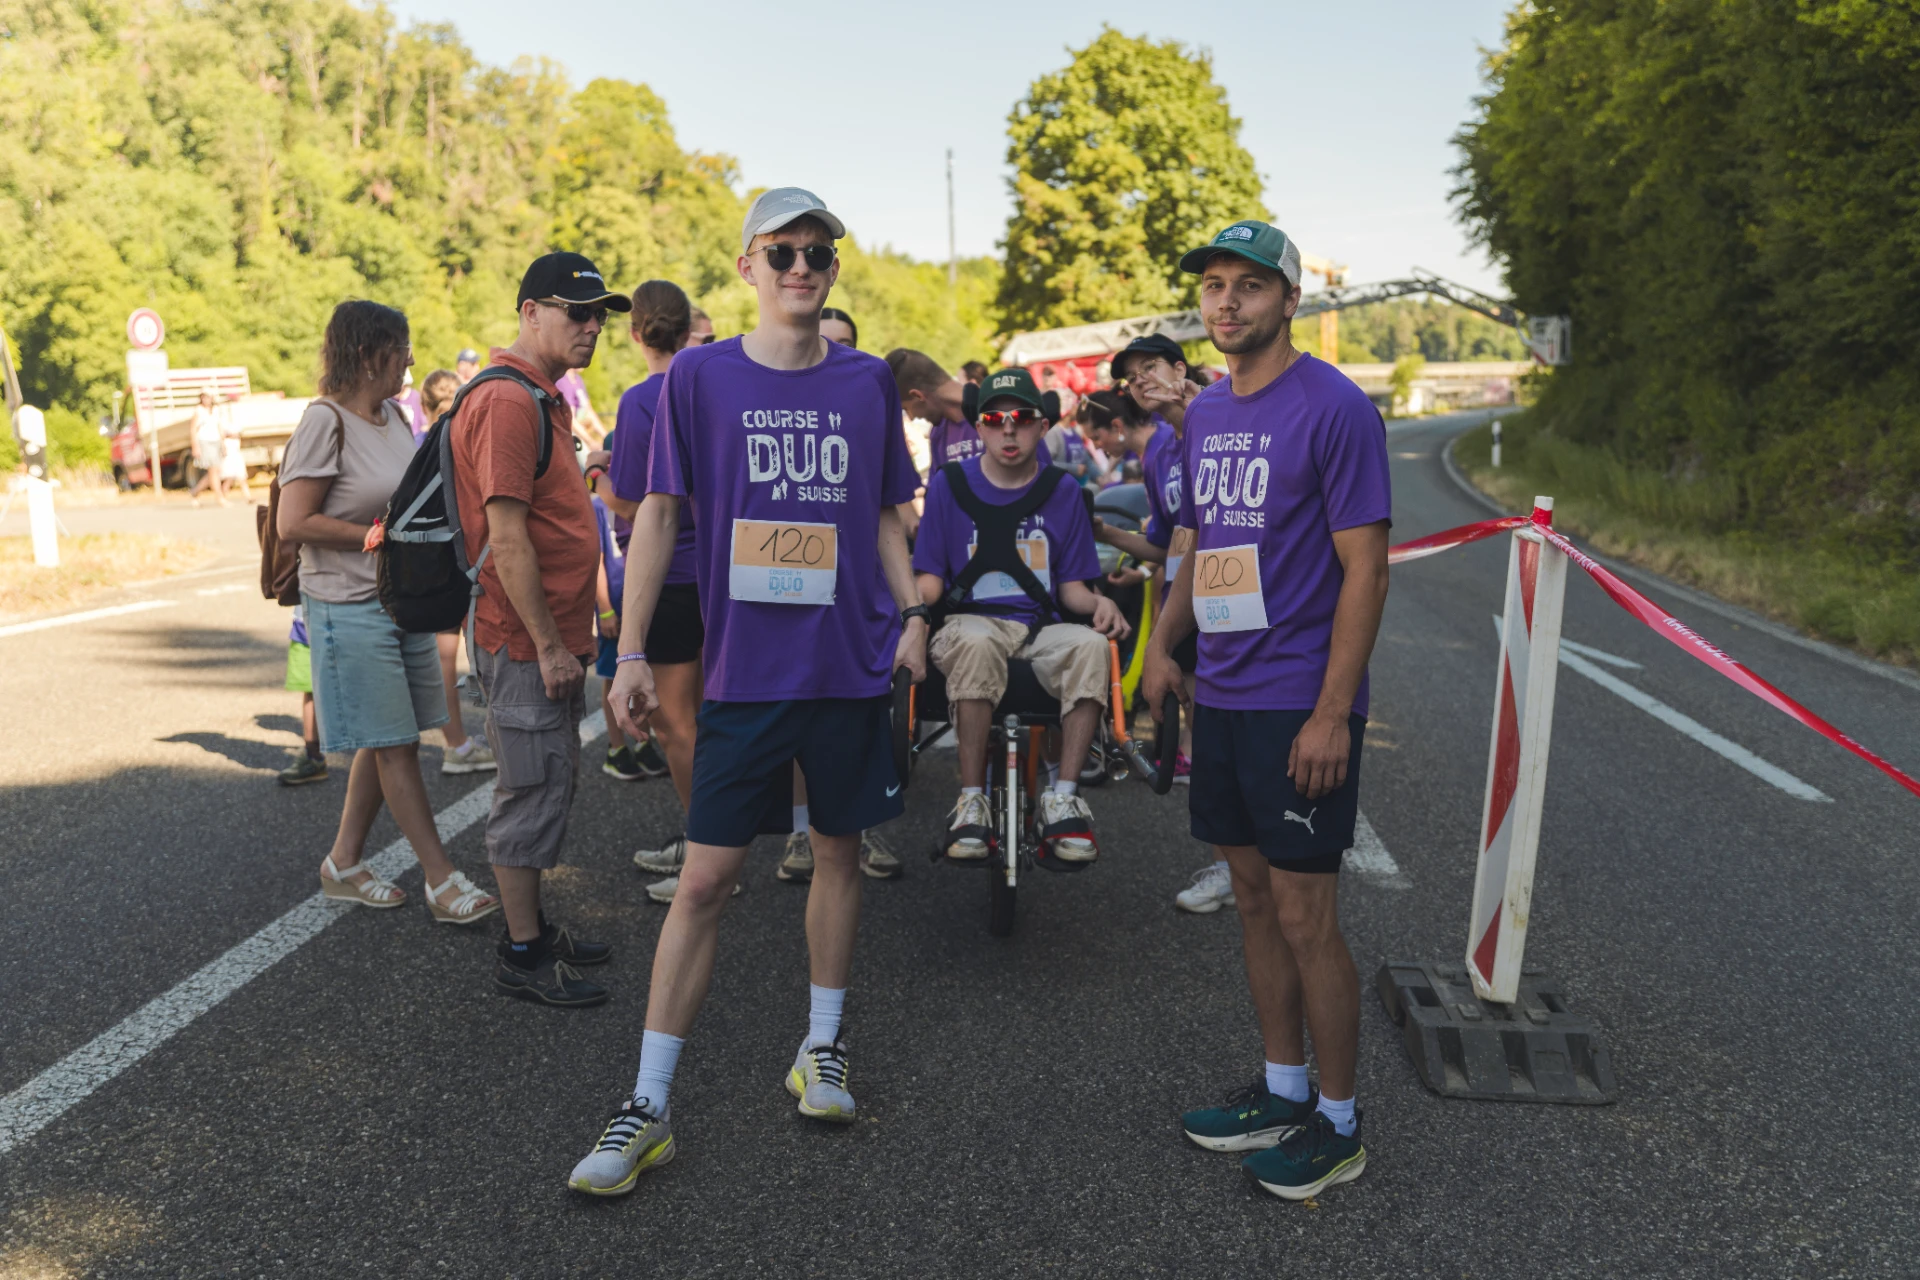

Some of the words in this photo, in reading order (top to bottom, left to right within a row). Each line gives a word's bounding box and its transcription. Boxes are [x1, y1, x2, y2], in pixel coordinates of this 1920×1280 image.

[992, 375, 1016, 390] CAT
[742, 410, 818, 429] COURSE
[1202, 432, 1254, 453] COURSE
[747, 433, 849, 484] DUO
[1194, 457, 1270, 508] DUO
[797, 486, 848, 503] SUISSE
[1222, 510, 1265, 528] SUISSE
[759, 528, 825, 565] 120
[1199, 554, 1244, 590] 120
[769, 576, 804, 592] DUO
[1206, 605, 1230, 620] DUO
